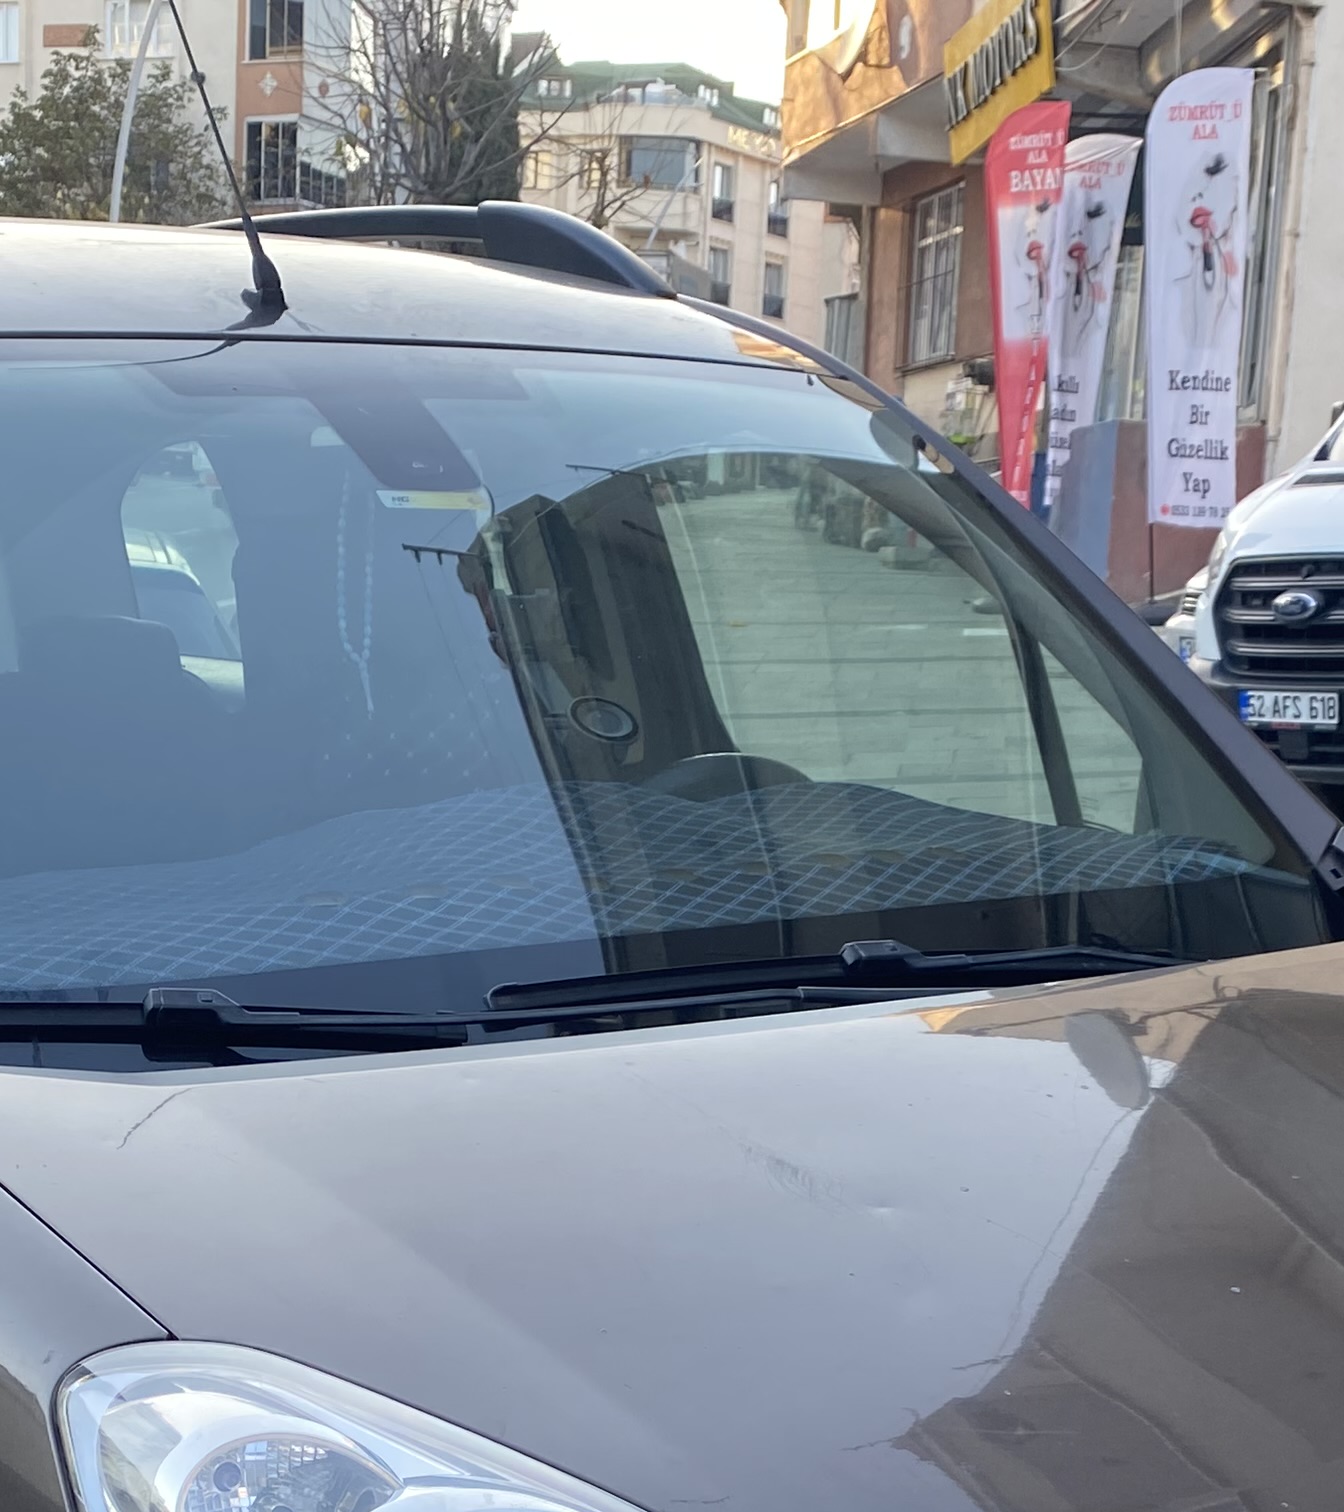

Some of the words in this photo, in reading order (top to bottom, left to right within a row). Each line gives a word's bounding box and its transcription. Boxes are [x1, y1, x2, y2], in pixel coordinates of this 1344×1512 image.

[1192, 123, 1218, 140] ALA
[1168, 370, 1232, 392] Kendine
[1190, 404, 1211, 425] Bir
[1167, 438, 1230, 461] Güzellik
[1182, 472, 1211, 499] Yap
[1273, 695, 1302, 719] AFS
[1309, 695, 1336, 720] 618
